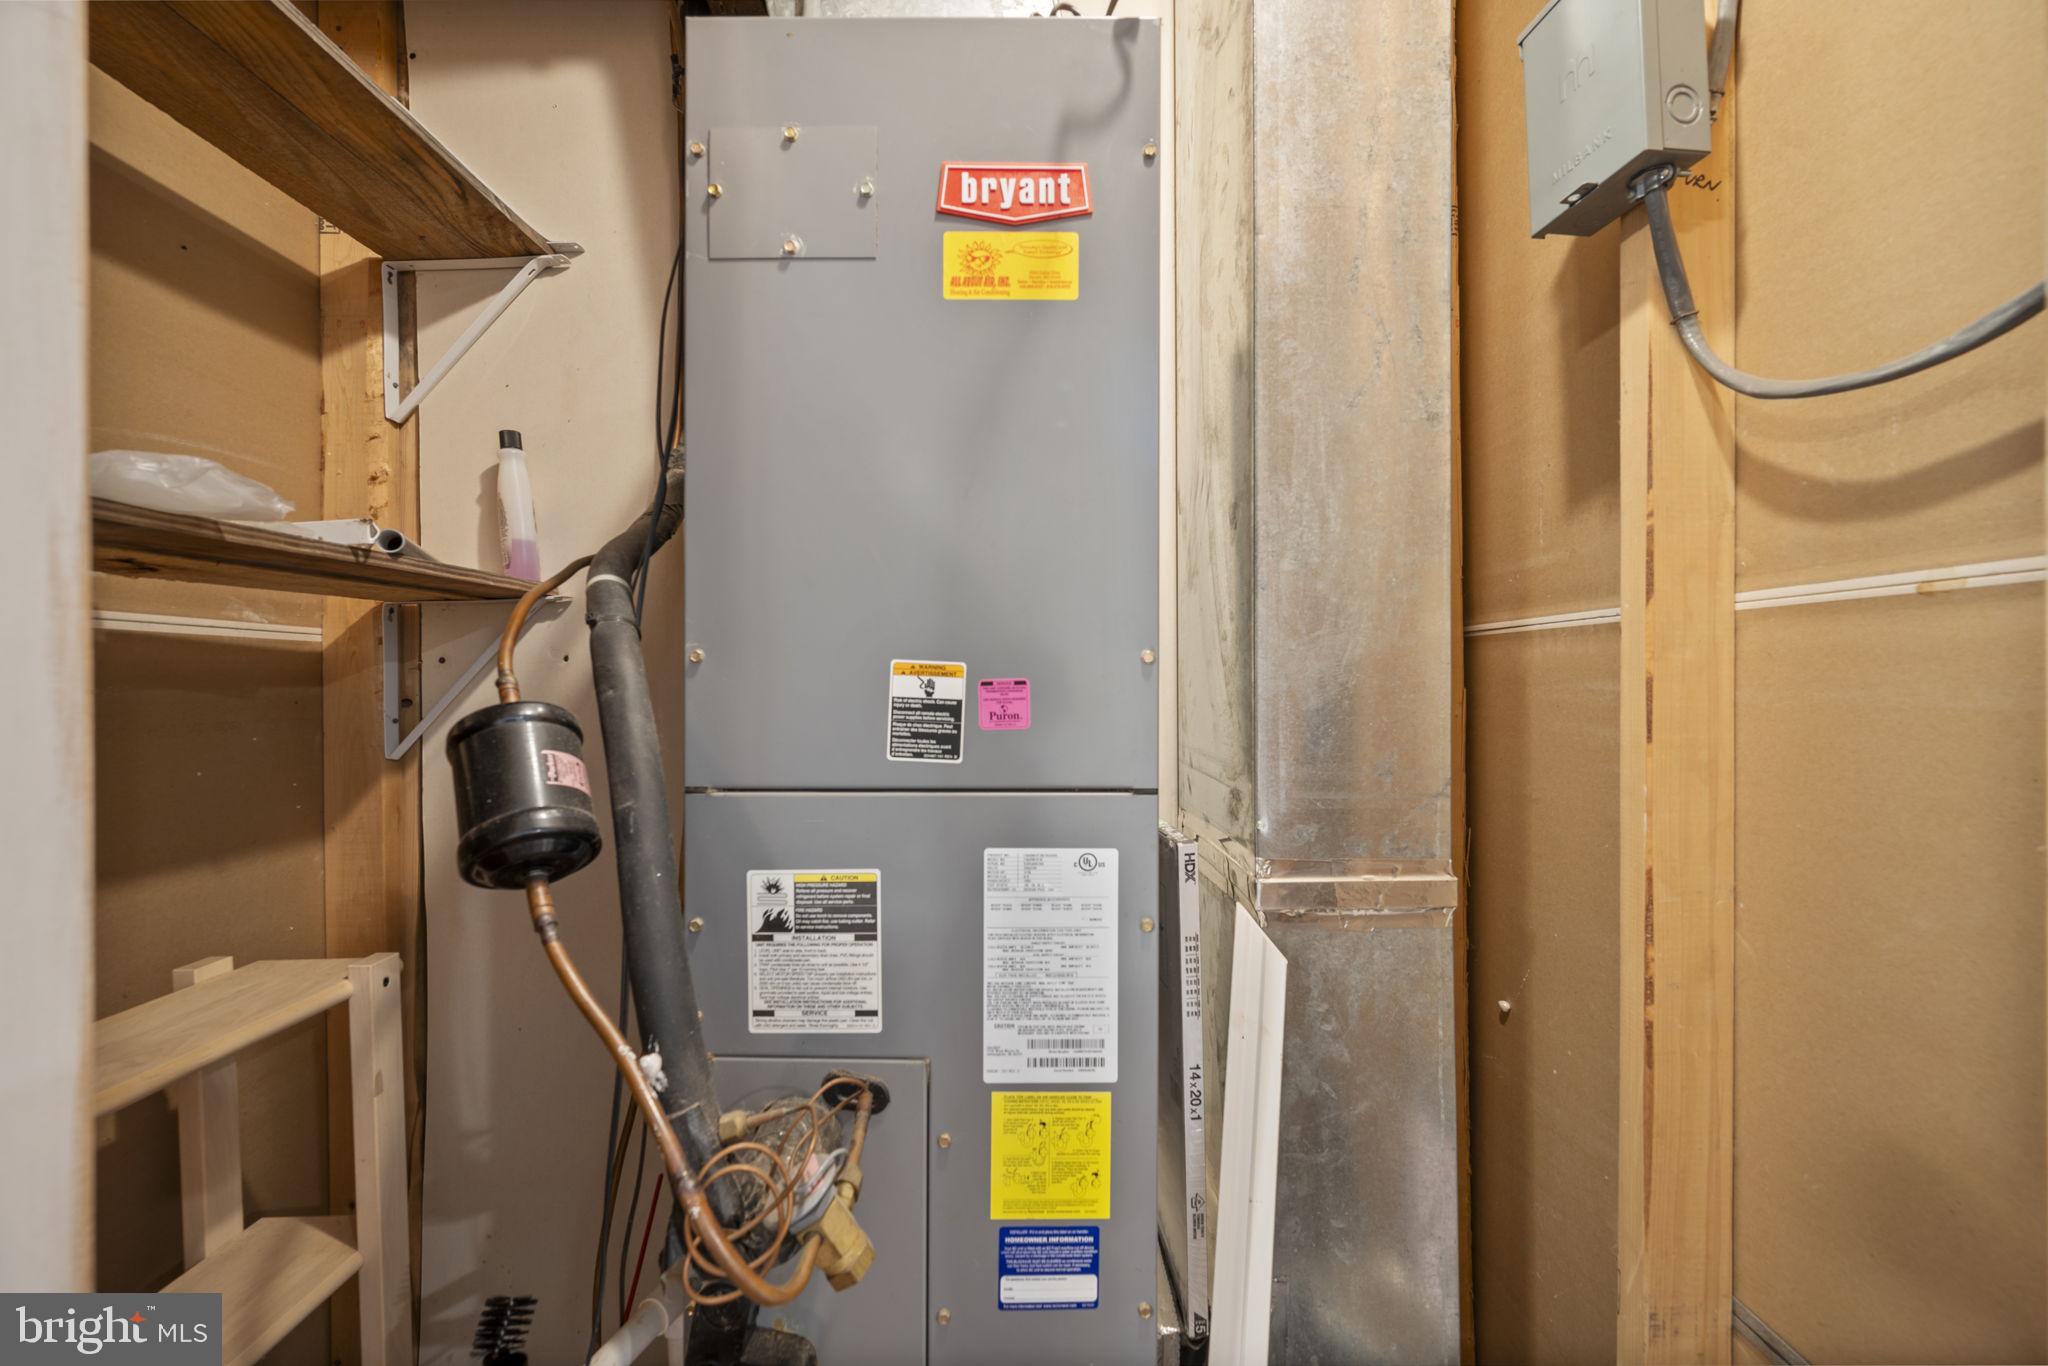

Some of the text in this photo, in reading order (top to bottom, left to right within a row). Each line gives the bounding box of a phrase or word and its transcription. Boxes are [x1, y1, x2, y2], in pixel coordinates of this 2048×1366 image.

[961, 171, 1071, 209] bryant
[990, 711, 1020, 721] Puron
[1184, 852, 1196, 883] HDX
